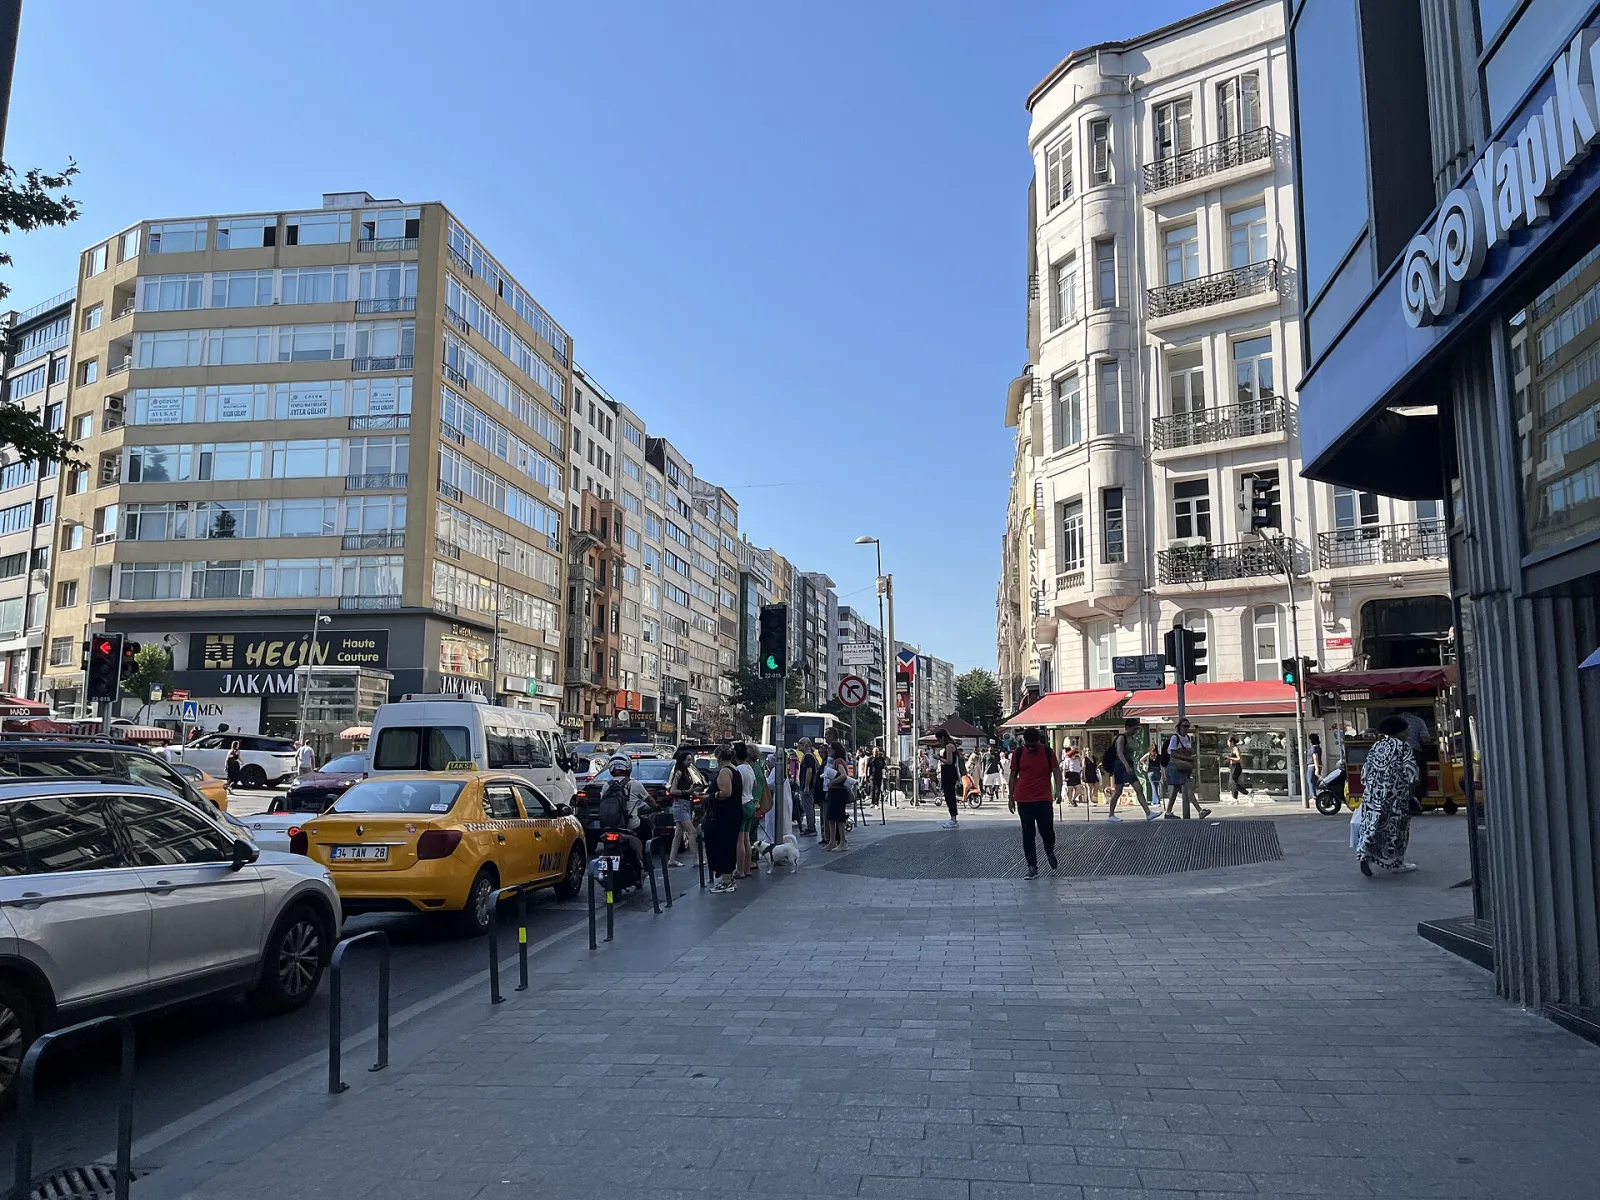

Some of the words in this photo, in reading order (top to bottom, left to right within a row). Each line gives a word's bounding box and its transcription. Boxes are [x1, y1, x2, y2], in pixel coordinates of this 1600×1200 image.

[246, 634, 330, 668] HELİN
[342, 638, 376, 649] Haute
[337, 652, 380, 662] Couture
[10, 708, 30, 716] MADO
[166, 704, 224, 716] JAMEN
[337, 848, 346, 858] 34
[352, 848, 366, 858] TAN
[374, 848, 386, 858] 28
[538, 853, 553, 873] TAN
